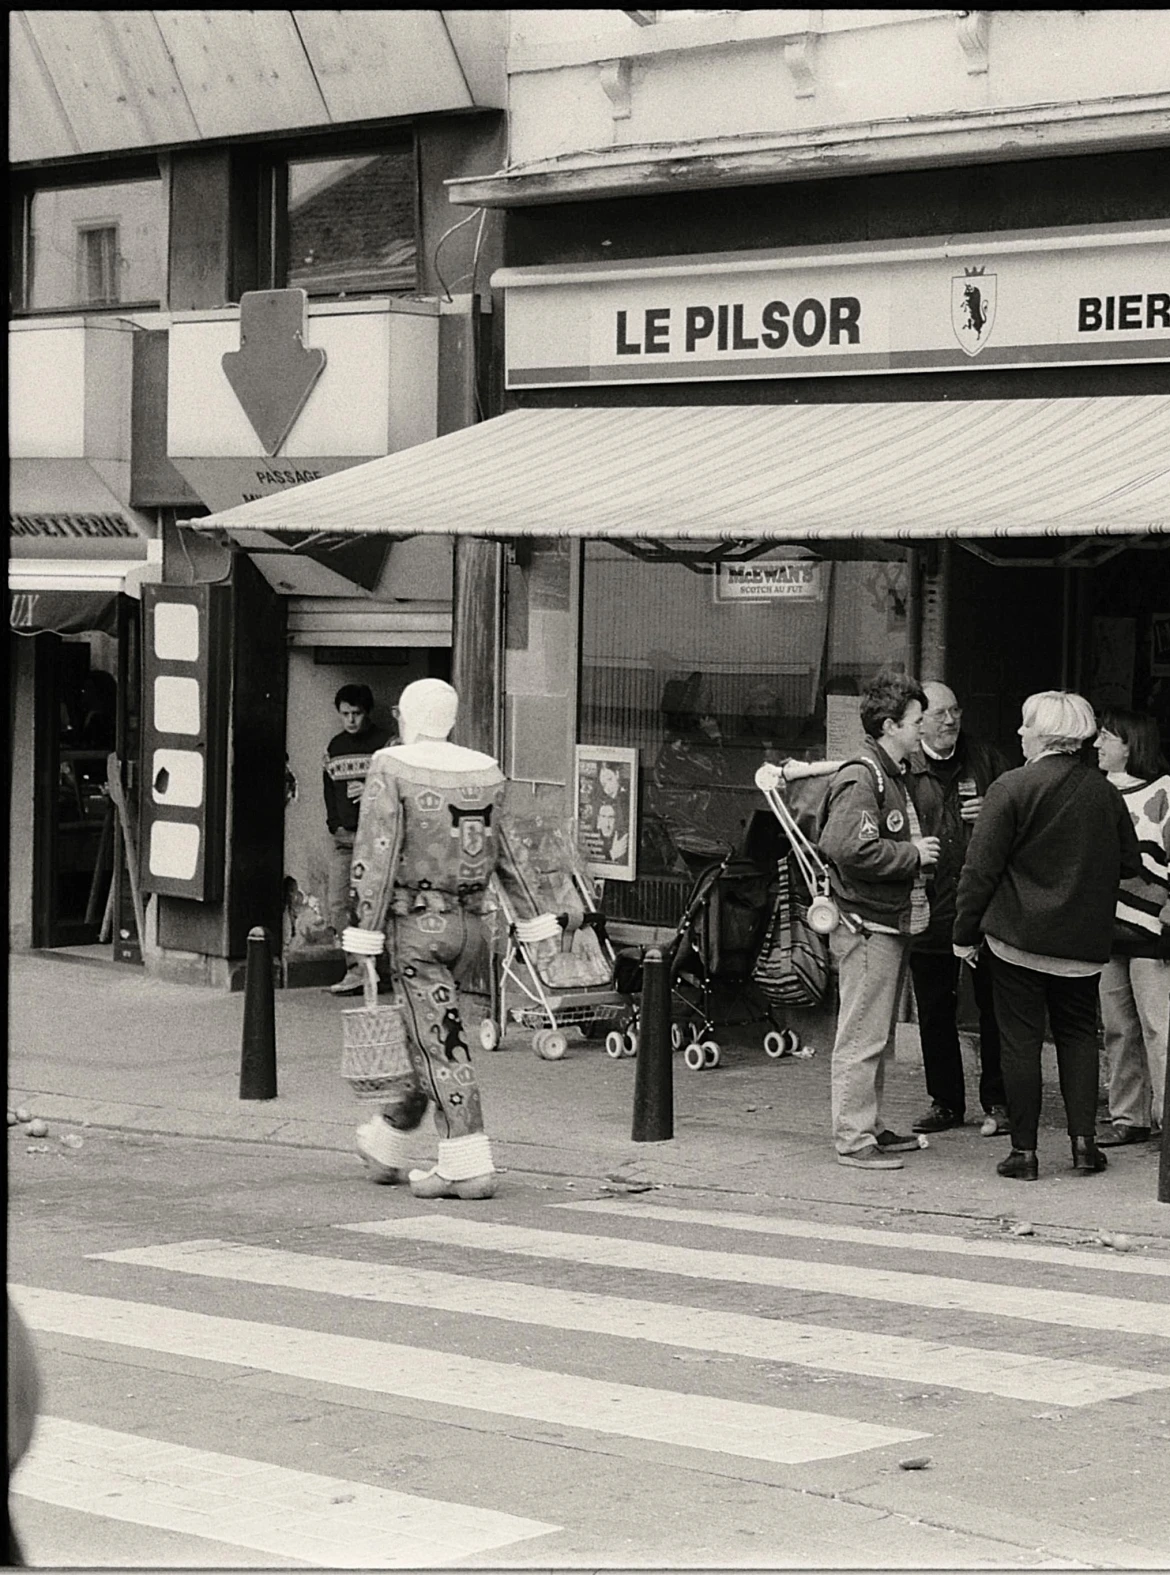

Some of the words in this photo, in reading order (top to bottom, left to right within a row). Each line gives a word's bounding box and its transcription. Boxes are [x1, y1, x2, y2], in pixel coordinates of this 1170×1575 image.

[616, 308, 671, 355] LE
[685, 297, 861, 352] PILSOR
[256, 470, 322, 484] PASSAGE
[740, 586, 772, 594] SCOTCH
